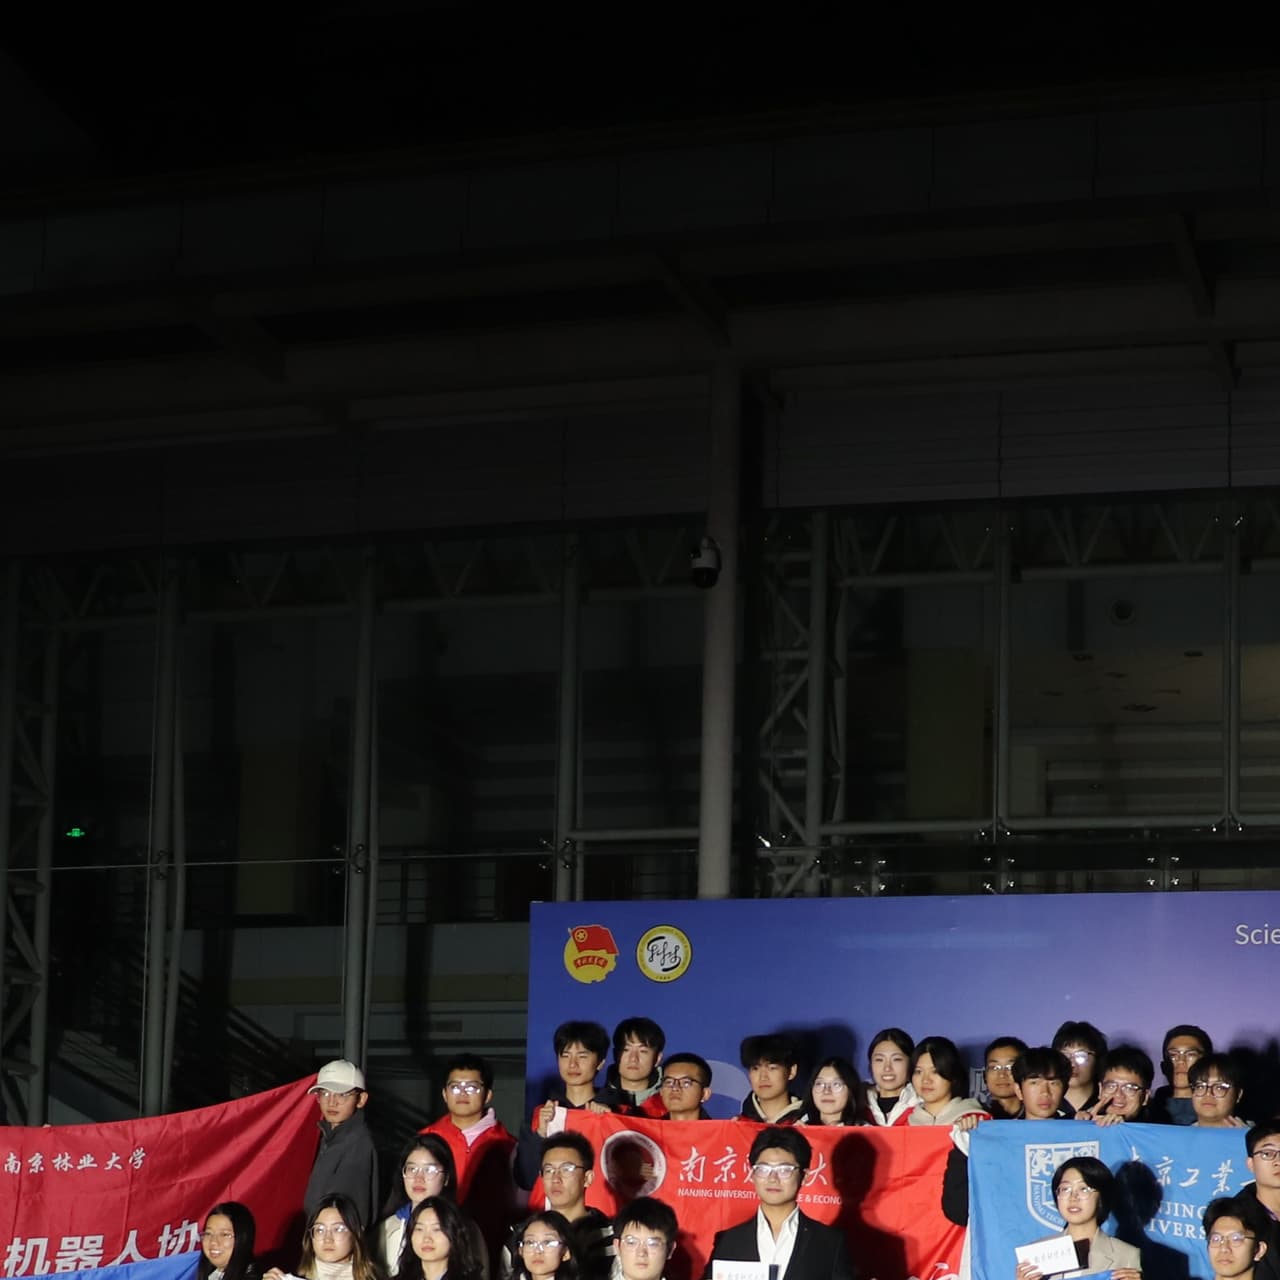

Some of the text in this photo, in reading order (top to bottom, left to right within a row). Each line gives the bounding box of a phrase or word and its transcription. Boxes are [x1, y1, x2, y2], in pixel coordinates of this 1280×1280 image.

[3, 1147, 147, 1175] 南京林业大学
[678, 1188, 713, 1198] NANJING
[714, 1189, 758, 1200] UNIVERSITY
